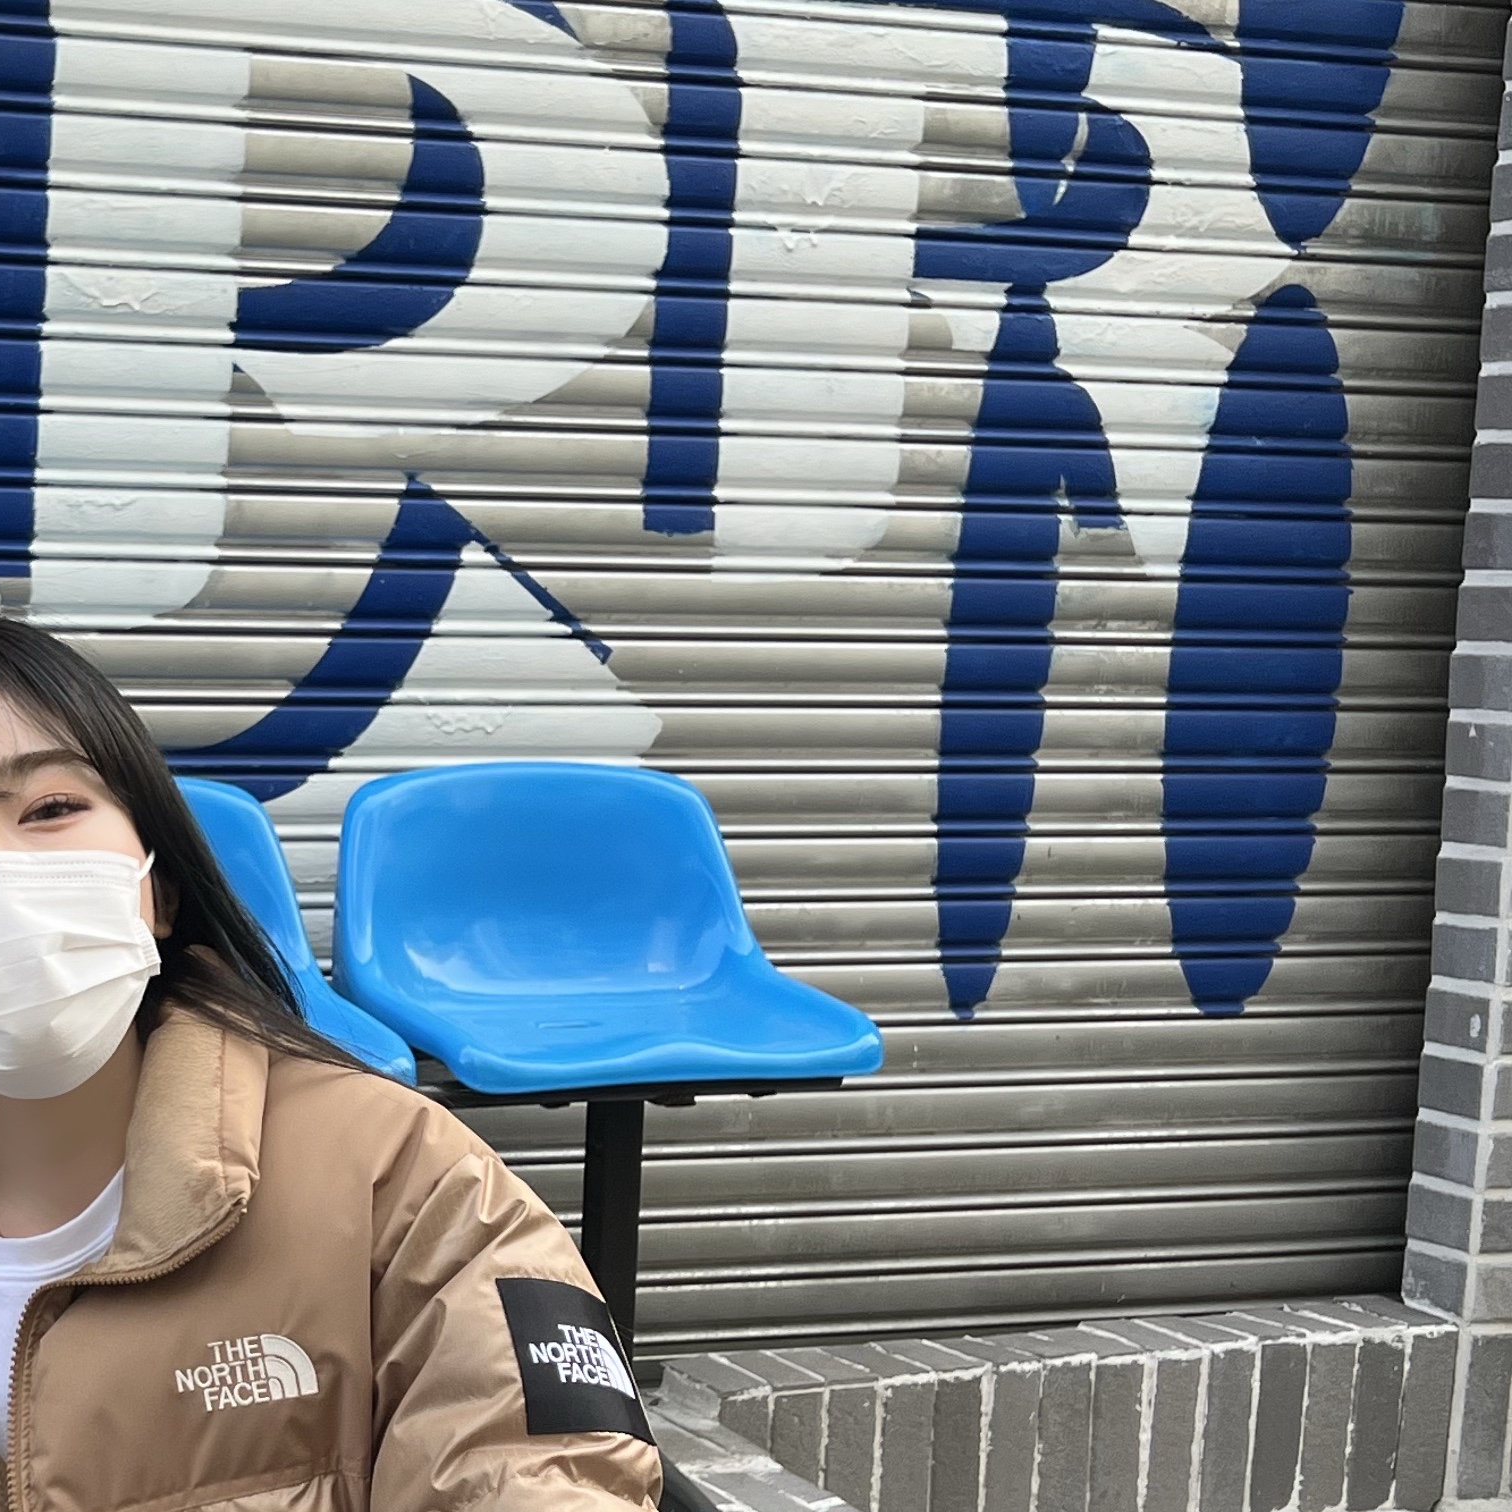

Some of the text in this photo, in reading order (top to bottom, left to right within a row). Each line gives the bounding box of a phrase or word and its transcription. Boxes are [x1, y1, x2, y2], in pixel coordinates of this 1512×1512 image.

[557, 1323, 598, 1348] THE
[207, 1336, 262, 1363] THE
[528, 1342, 604, 1366] NORTH
[174, 1357, 266, 1393] NORTH
[557, 1362, 610, 1386] FACE
[203, 1380, 270, 1412] FACE
